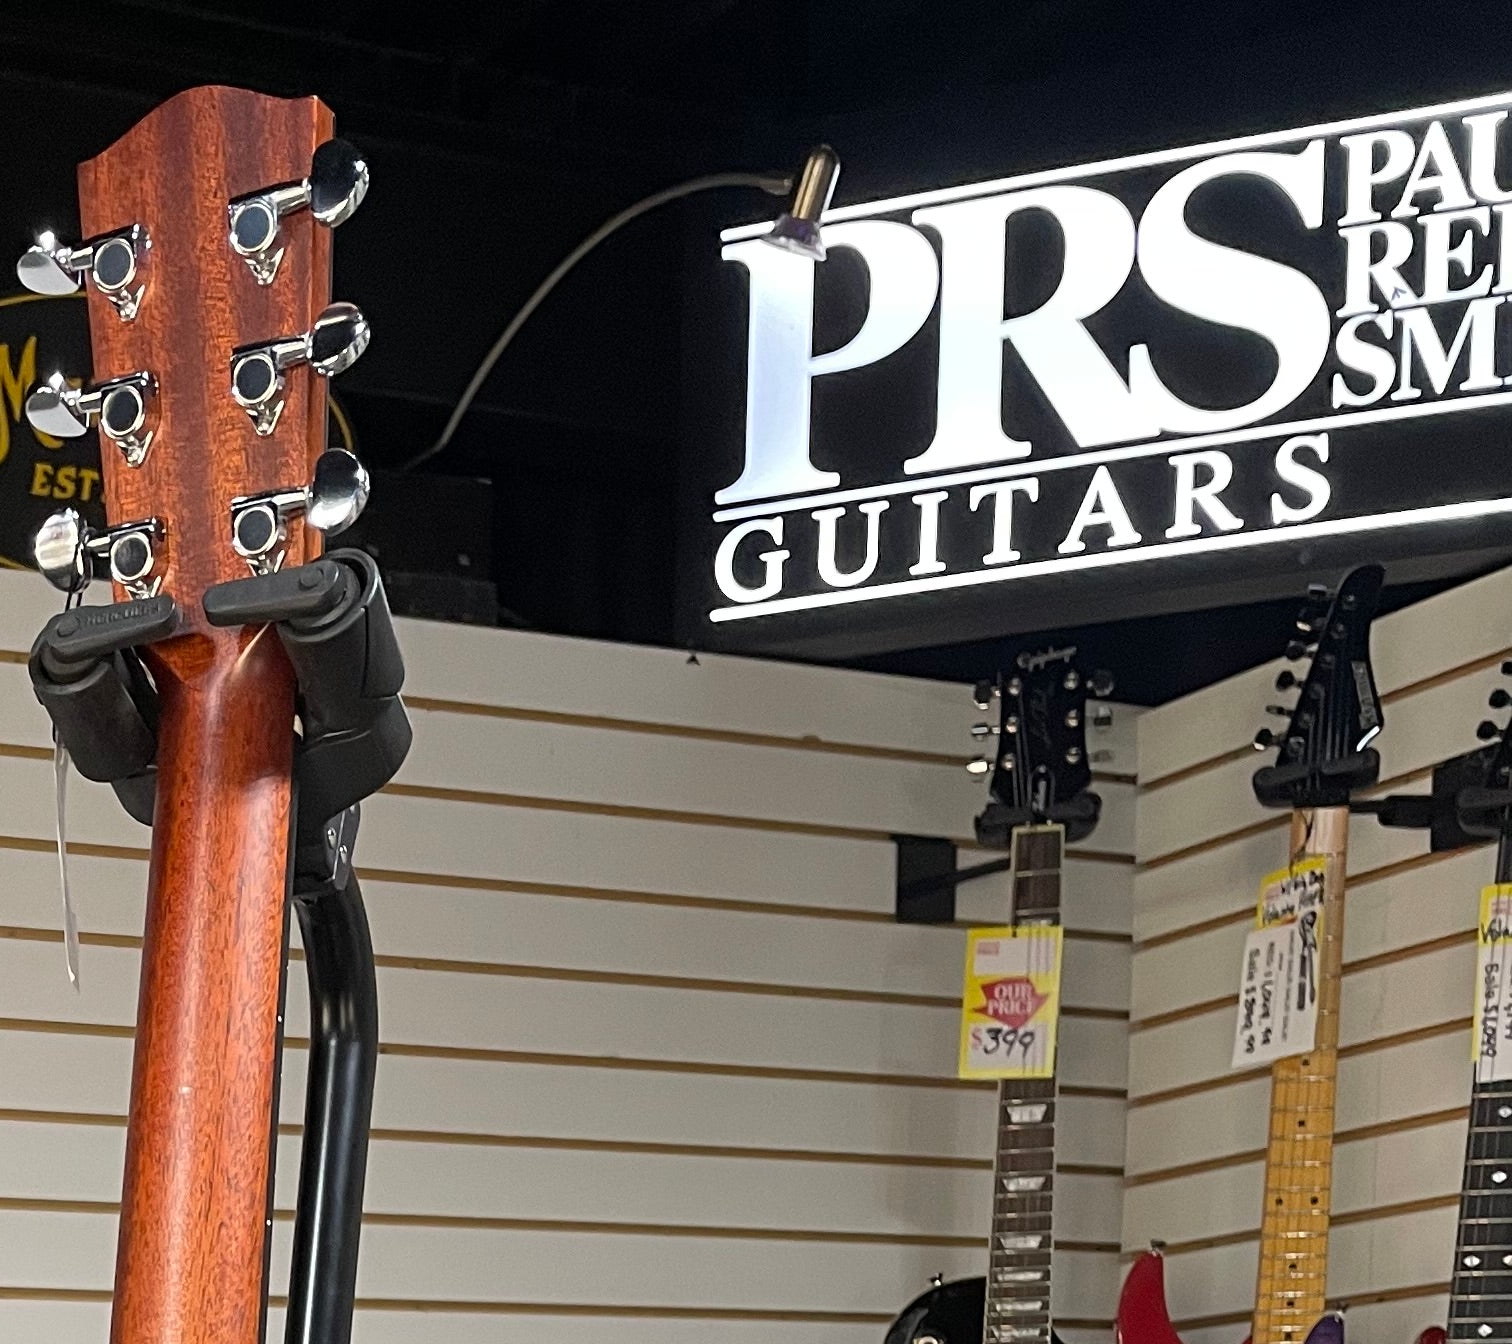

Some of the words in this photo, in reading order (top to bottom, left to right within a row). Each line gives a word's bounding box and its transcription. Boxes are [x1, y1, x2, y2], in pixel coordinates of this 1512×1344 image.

[1336, 203, 1512, 318] RE
[715, 139, 1332, 505] PRS
[1332, 294, 1512, 409] SM
[714, 432, 1332, 604] GUITARS
[971, 1026, 1035, 1056] $399
[988, 998, 1035, 1016] PRICE
[994, 983, 1033, 1000] OUR
